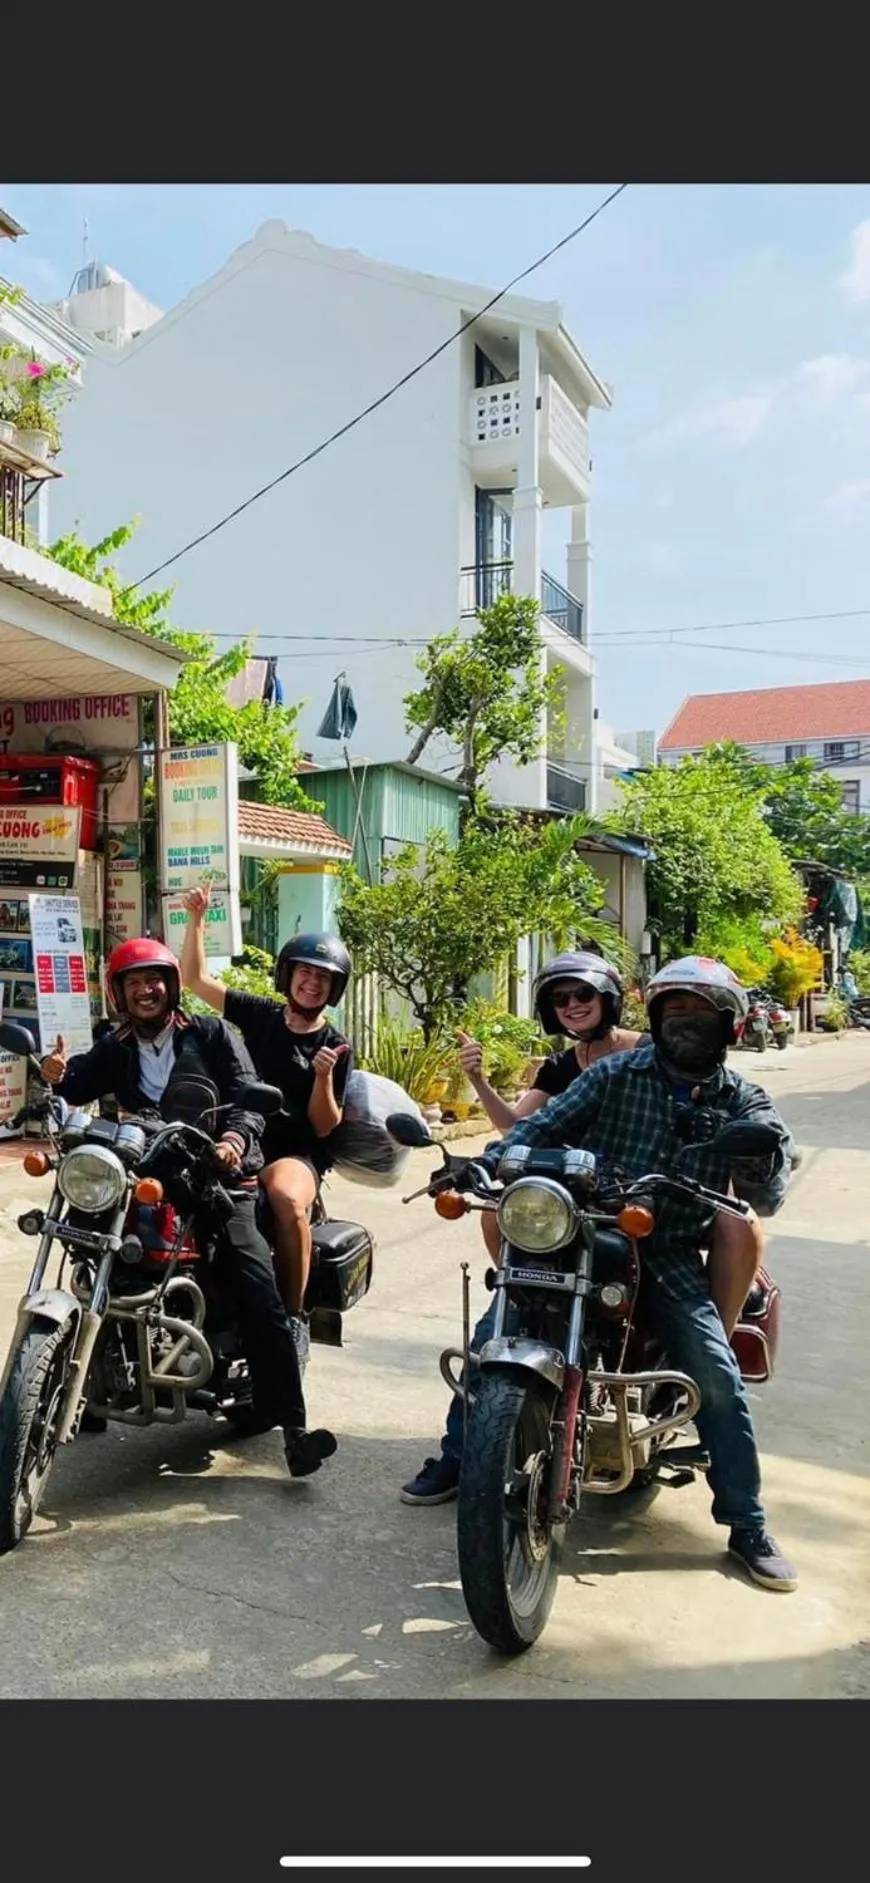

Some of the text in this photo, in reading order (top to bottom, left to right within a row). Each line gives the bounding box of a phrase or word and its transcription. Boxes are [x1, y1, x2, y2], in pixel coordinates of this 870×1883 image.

[24, 695, 130, 724] BOOKING OFFICE
[171, 748, 217, 760] MRS CUONG
[173, 786, 217, 802] DAILY TOUR
[6, 810, 27, 819] OFFICE
[168, 856, 210, 868] BANA HILLS
[517, 1271, 558, 1282] HONDA
